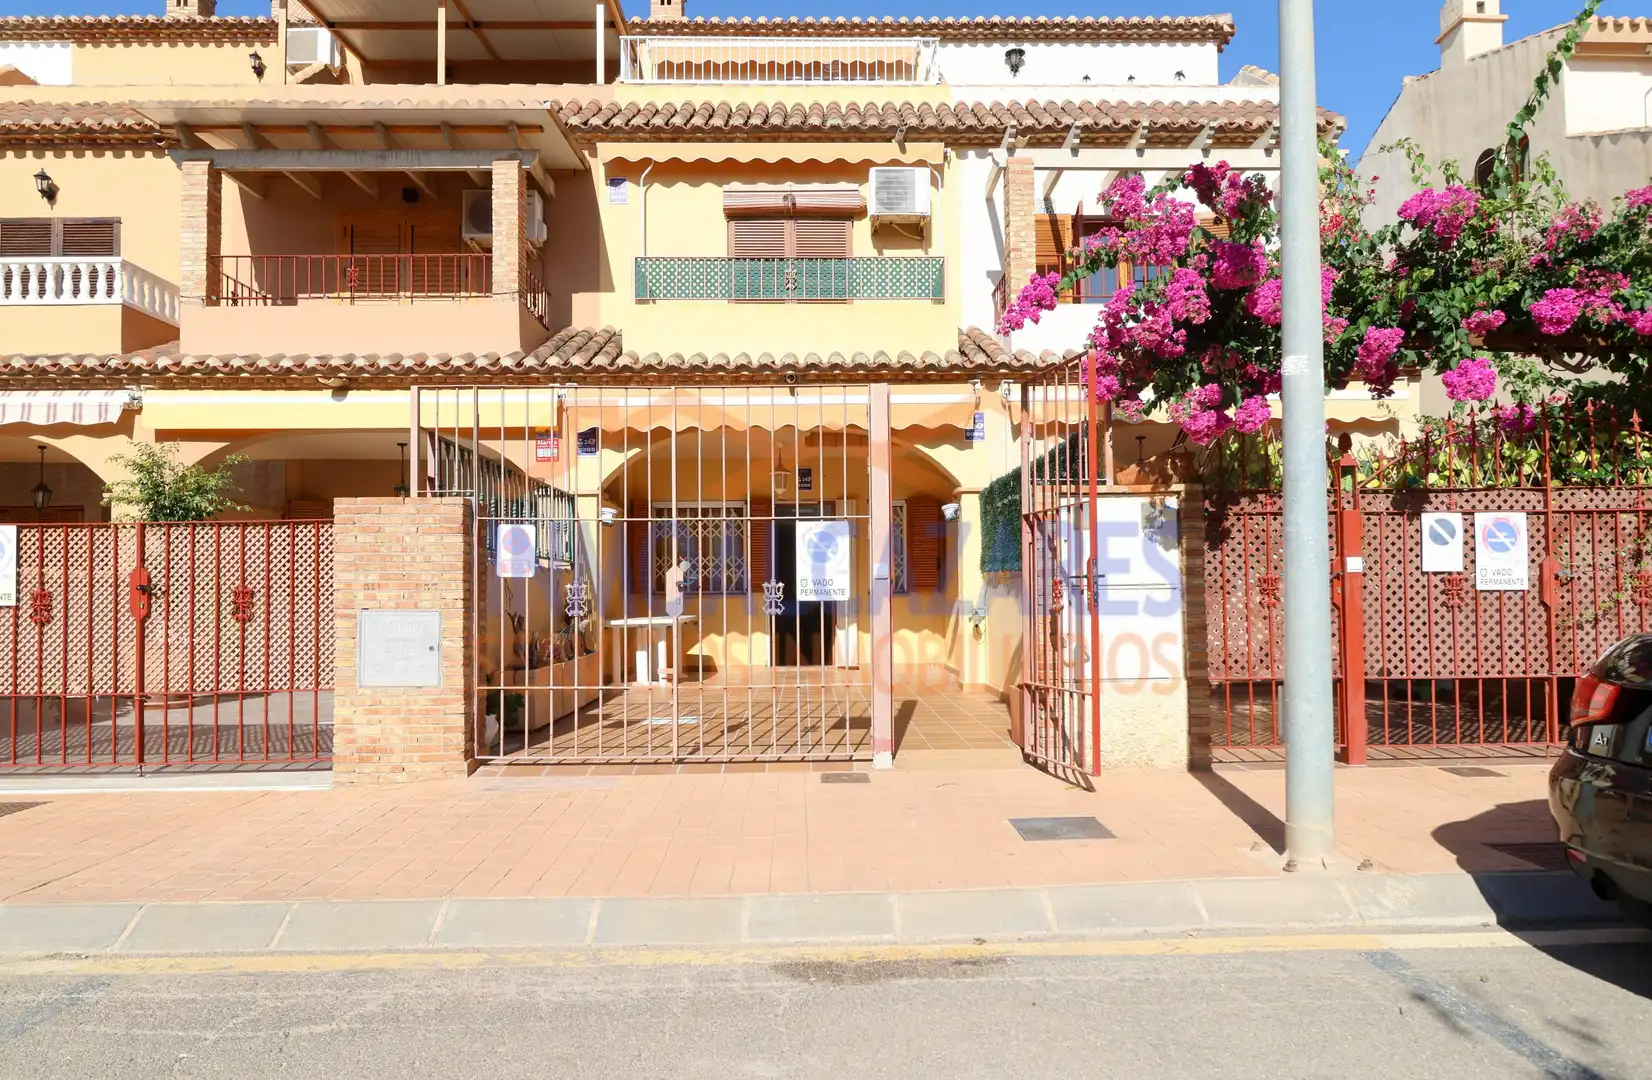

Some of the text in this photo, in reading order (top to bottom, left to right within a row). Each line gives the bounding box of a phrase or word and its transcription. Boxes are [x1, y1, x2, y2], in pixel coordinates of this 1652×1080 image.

[1492, 568, 1514, 577] VADO
[812, 579, 834, 587] VADO
[1480, 578, 1524, 586] PERMANENTE
[800, 588, 846, 596] PERMANENTE
[1594, 732, 1609, 747] A1
